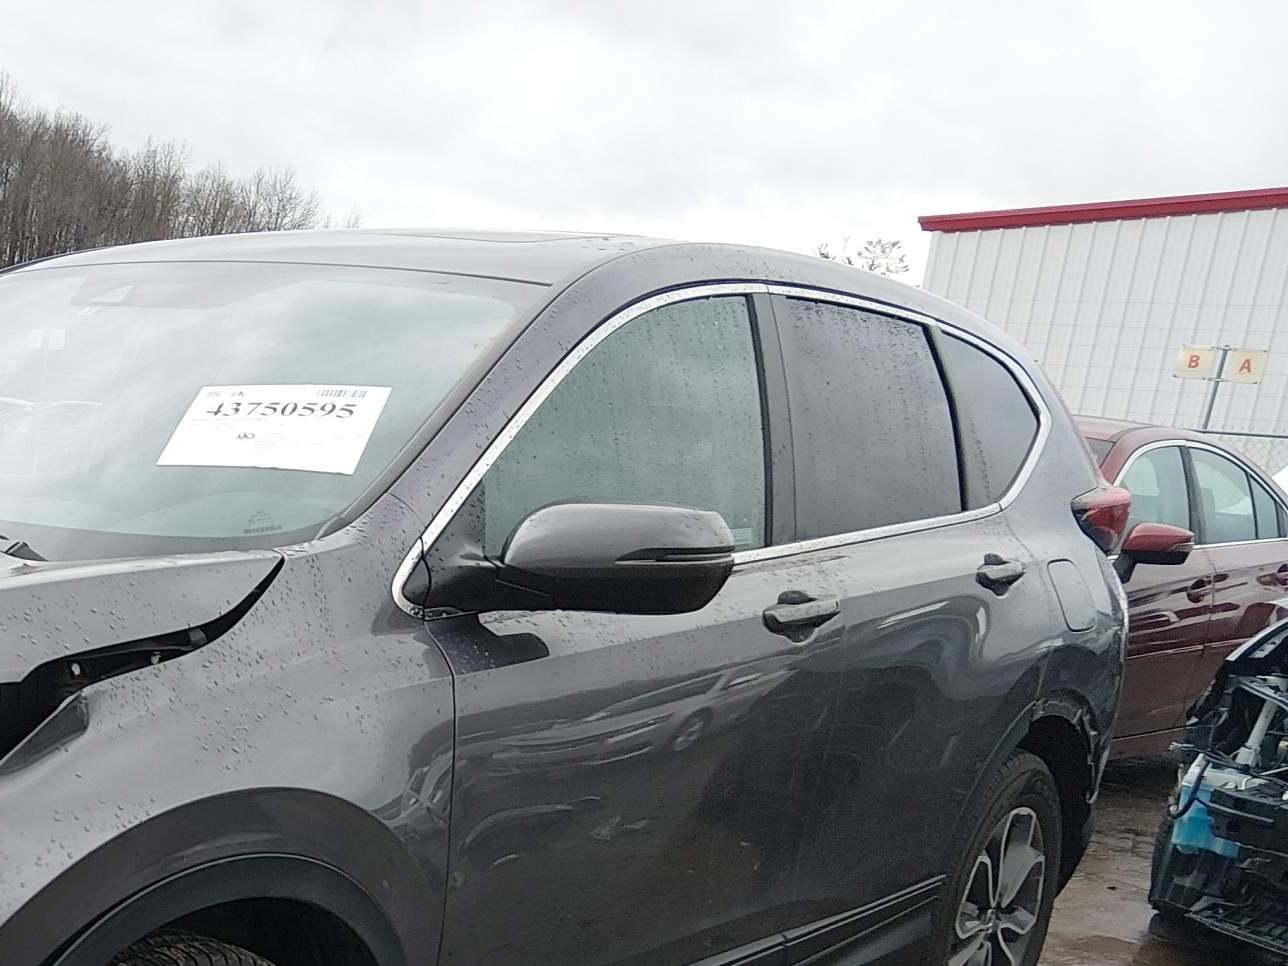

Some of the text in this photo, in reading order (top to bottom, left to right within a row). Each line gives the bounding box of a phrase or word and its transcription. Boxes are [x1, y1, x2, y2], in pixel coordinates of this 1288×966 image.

[1188, 355, 1200, 368] B
[1239, 359, 1252, 373] A
[206, 401, 358, 419] 43750595
